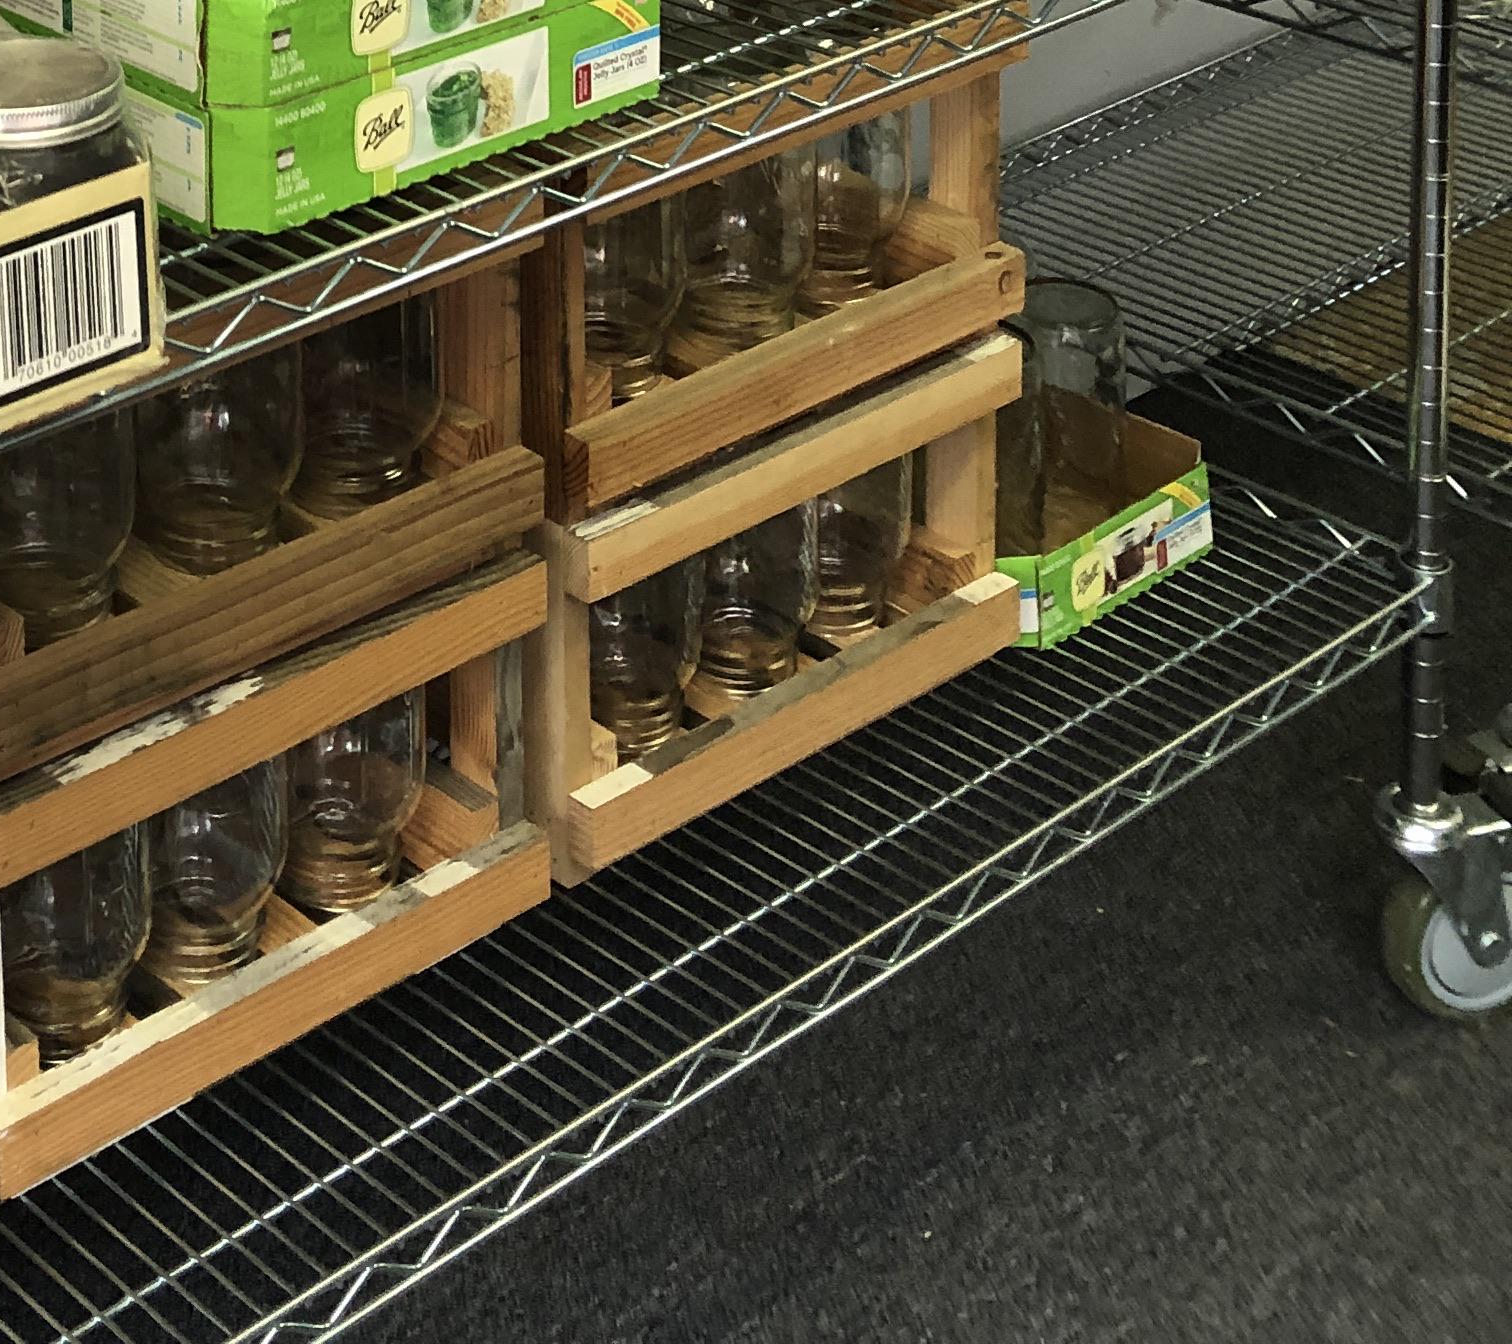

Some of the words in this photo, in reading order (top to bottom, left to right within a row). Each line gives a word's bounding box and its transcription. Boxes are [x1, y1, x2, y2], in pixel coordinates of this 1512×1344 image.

[362, 103, 405, 152] Ball
[18, 355, 62, 383] 70610
[68, 338, 112, 364] 00518
